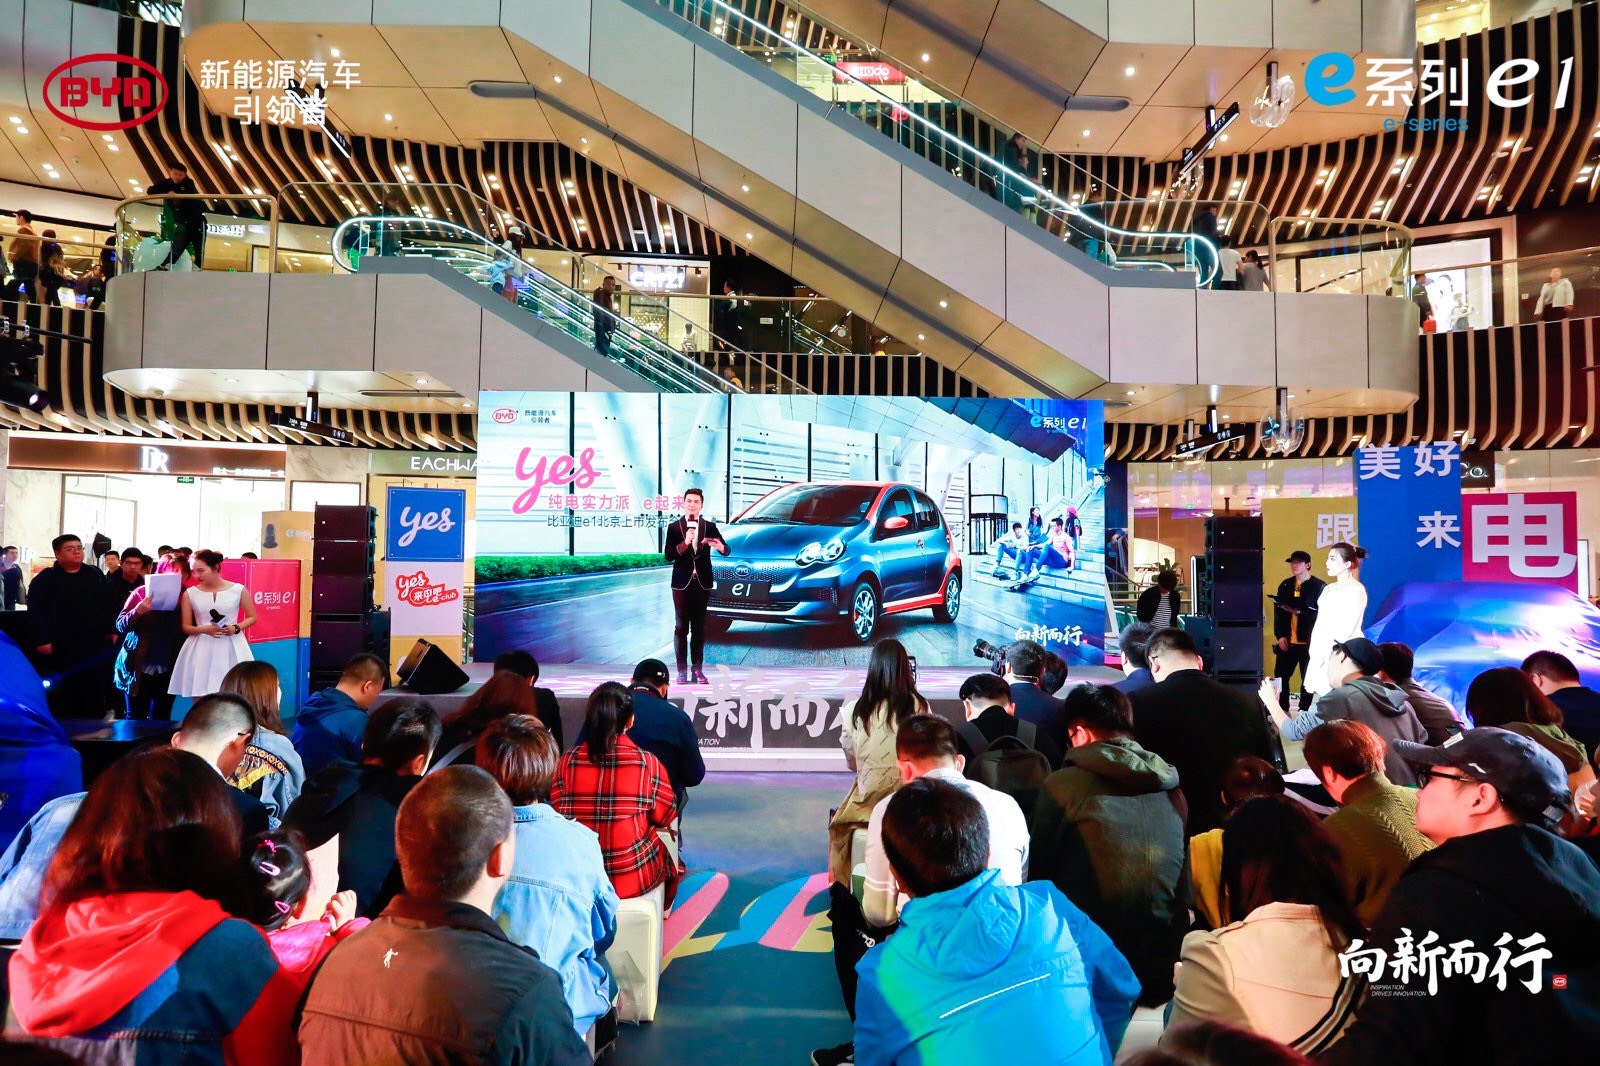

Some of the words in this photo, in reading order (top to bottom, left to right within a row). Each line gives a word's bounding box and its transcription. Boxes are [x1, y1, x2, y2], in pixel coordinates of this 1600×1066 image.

[512, 447, 601, 514] yes
[548, 494, 630, 510] 纯电实力派
[398, 506, 455, 547] yes
[1316, 513, 1356, 549] 跟
[1472, 494, 1577, 577] 电
[398, 573, 426, 598] yes
[1015, 624, 1083, 646] 向新而行
[667, 664, 856, 752] 新而
